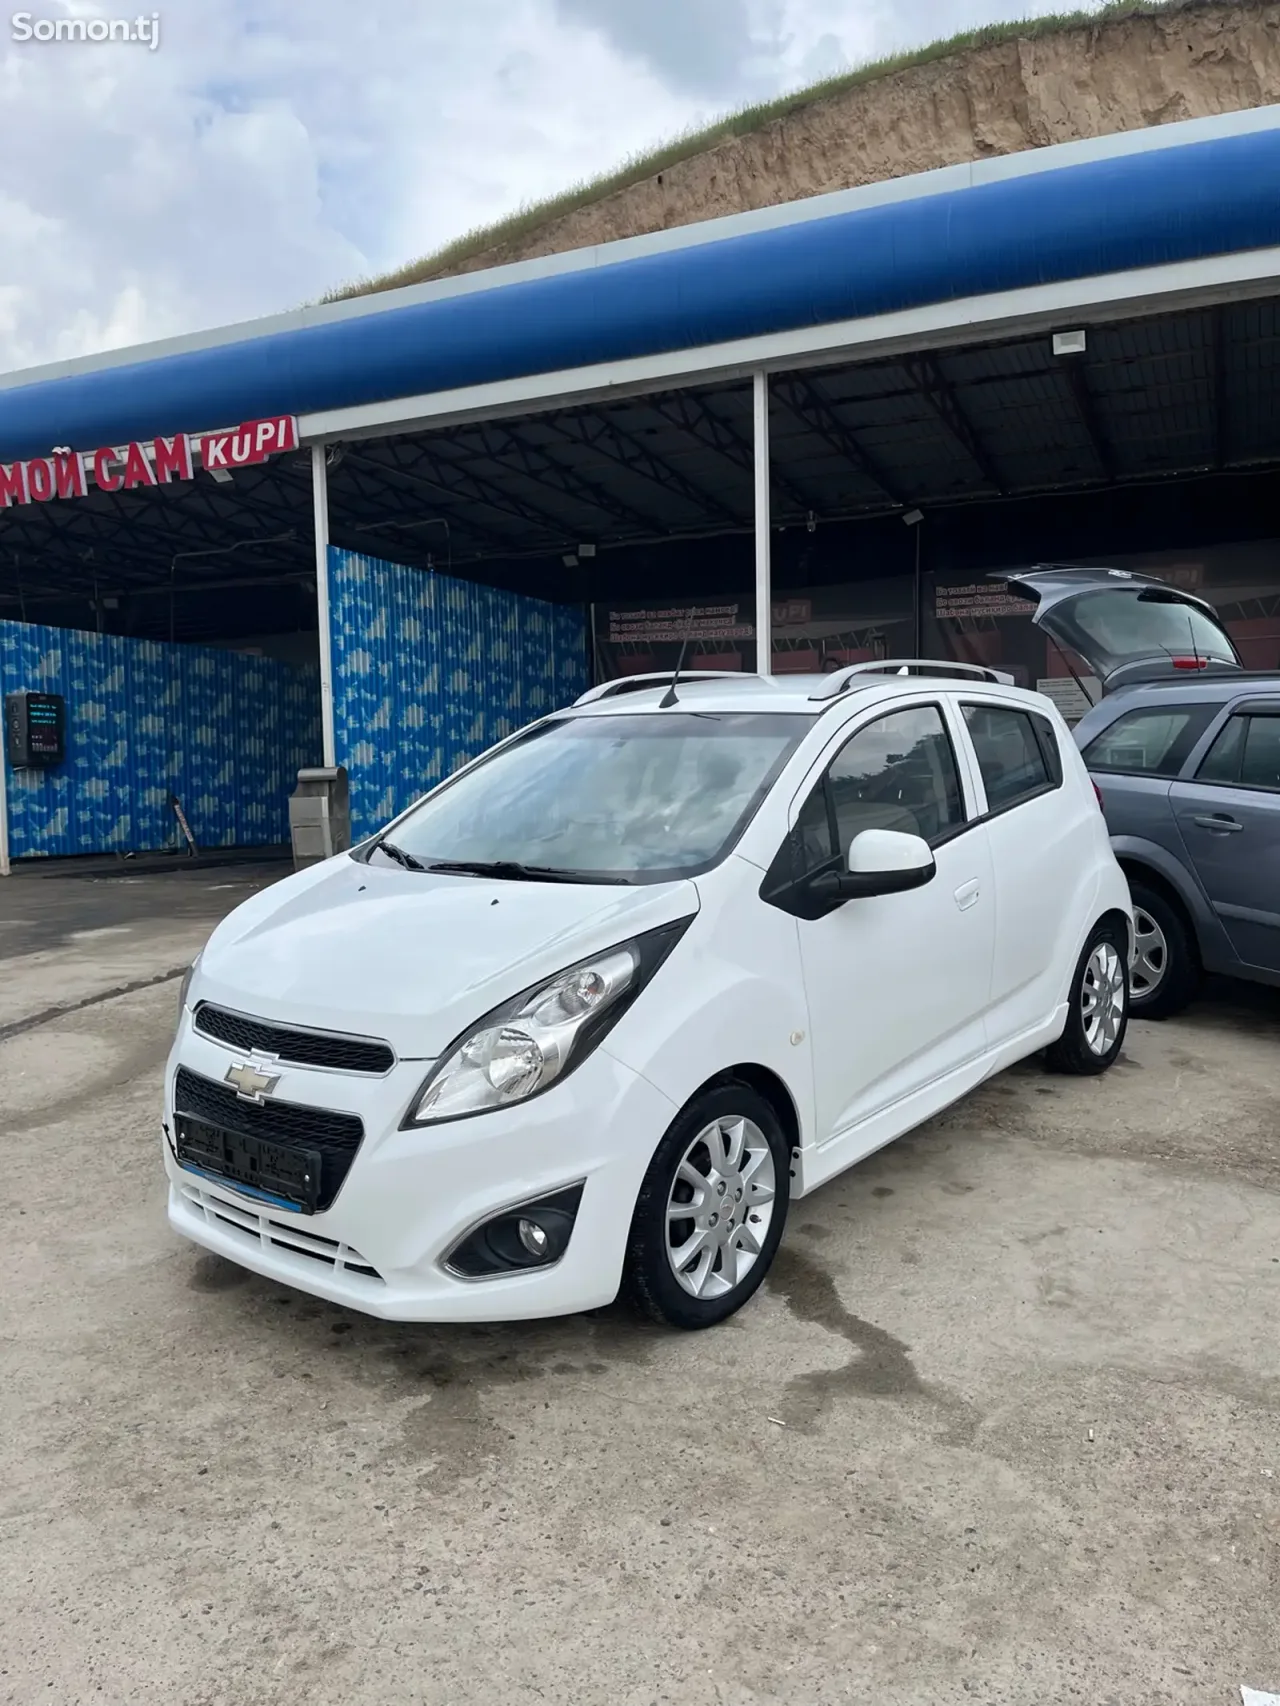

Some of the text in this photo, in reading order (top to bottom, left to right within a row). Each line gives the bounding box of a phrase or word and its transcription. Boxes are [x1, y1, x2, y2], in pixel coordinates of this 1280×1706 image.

[0, 433, 194, 507] МОЙ САМ
[207, 419, 289, 467] KUPI
